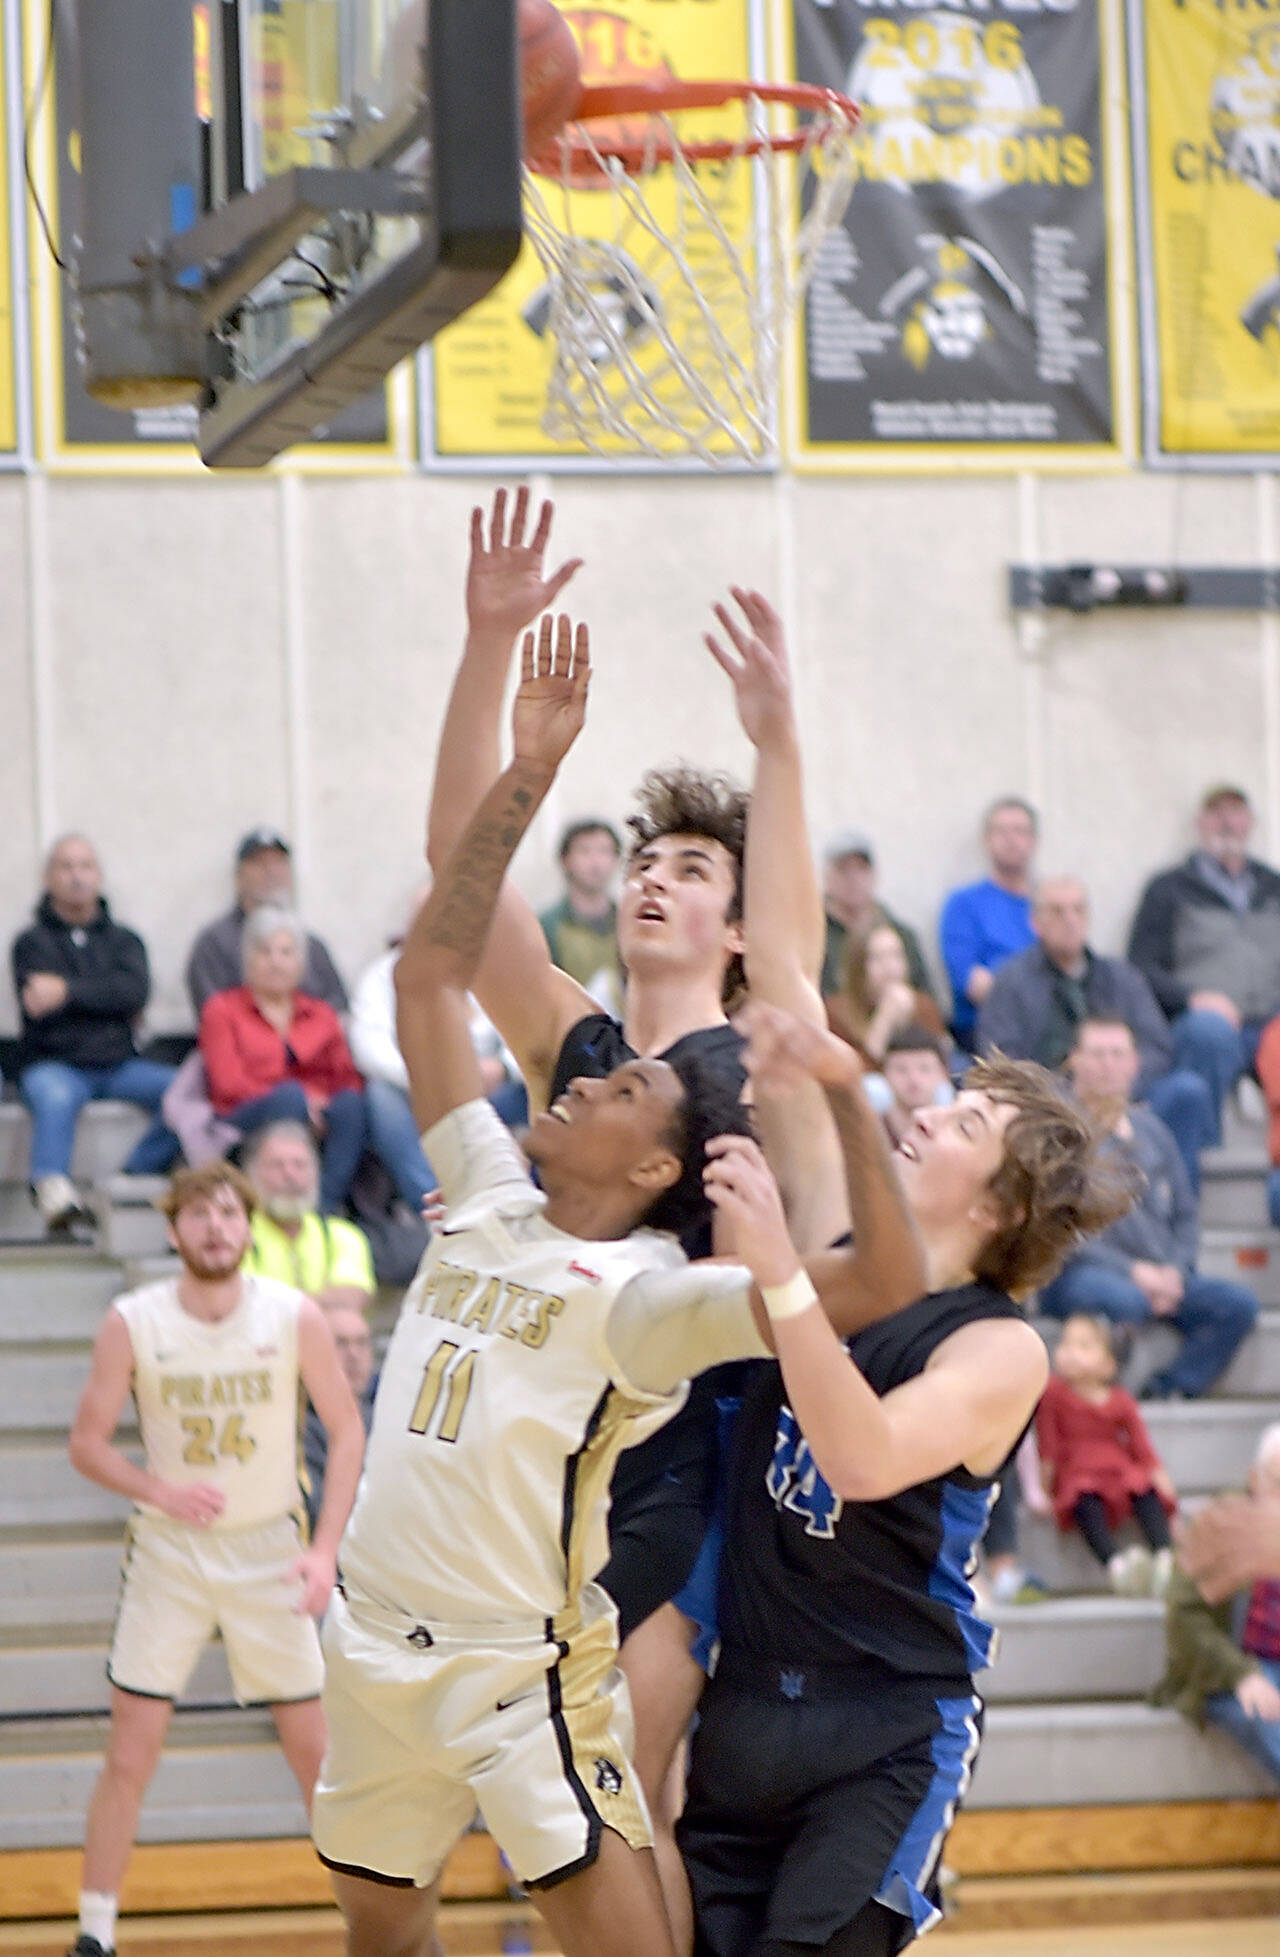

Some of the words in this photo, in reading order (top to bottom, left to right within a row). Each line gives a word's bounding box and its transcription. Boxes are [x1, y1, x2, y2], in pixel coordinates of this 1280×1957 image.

[566, 17, 662, 70] 16
[862, 18, 1024, 72] 2016
[160, 1369, 273, 1408] PIRATES
[408, 1339, 480, 1443] 11
[181, 1414, 257, 1466] 24
